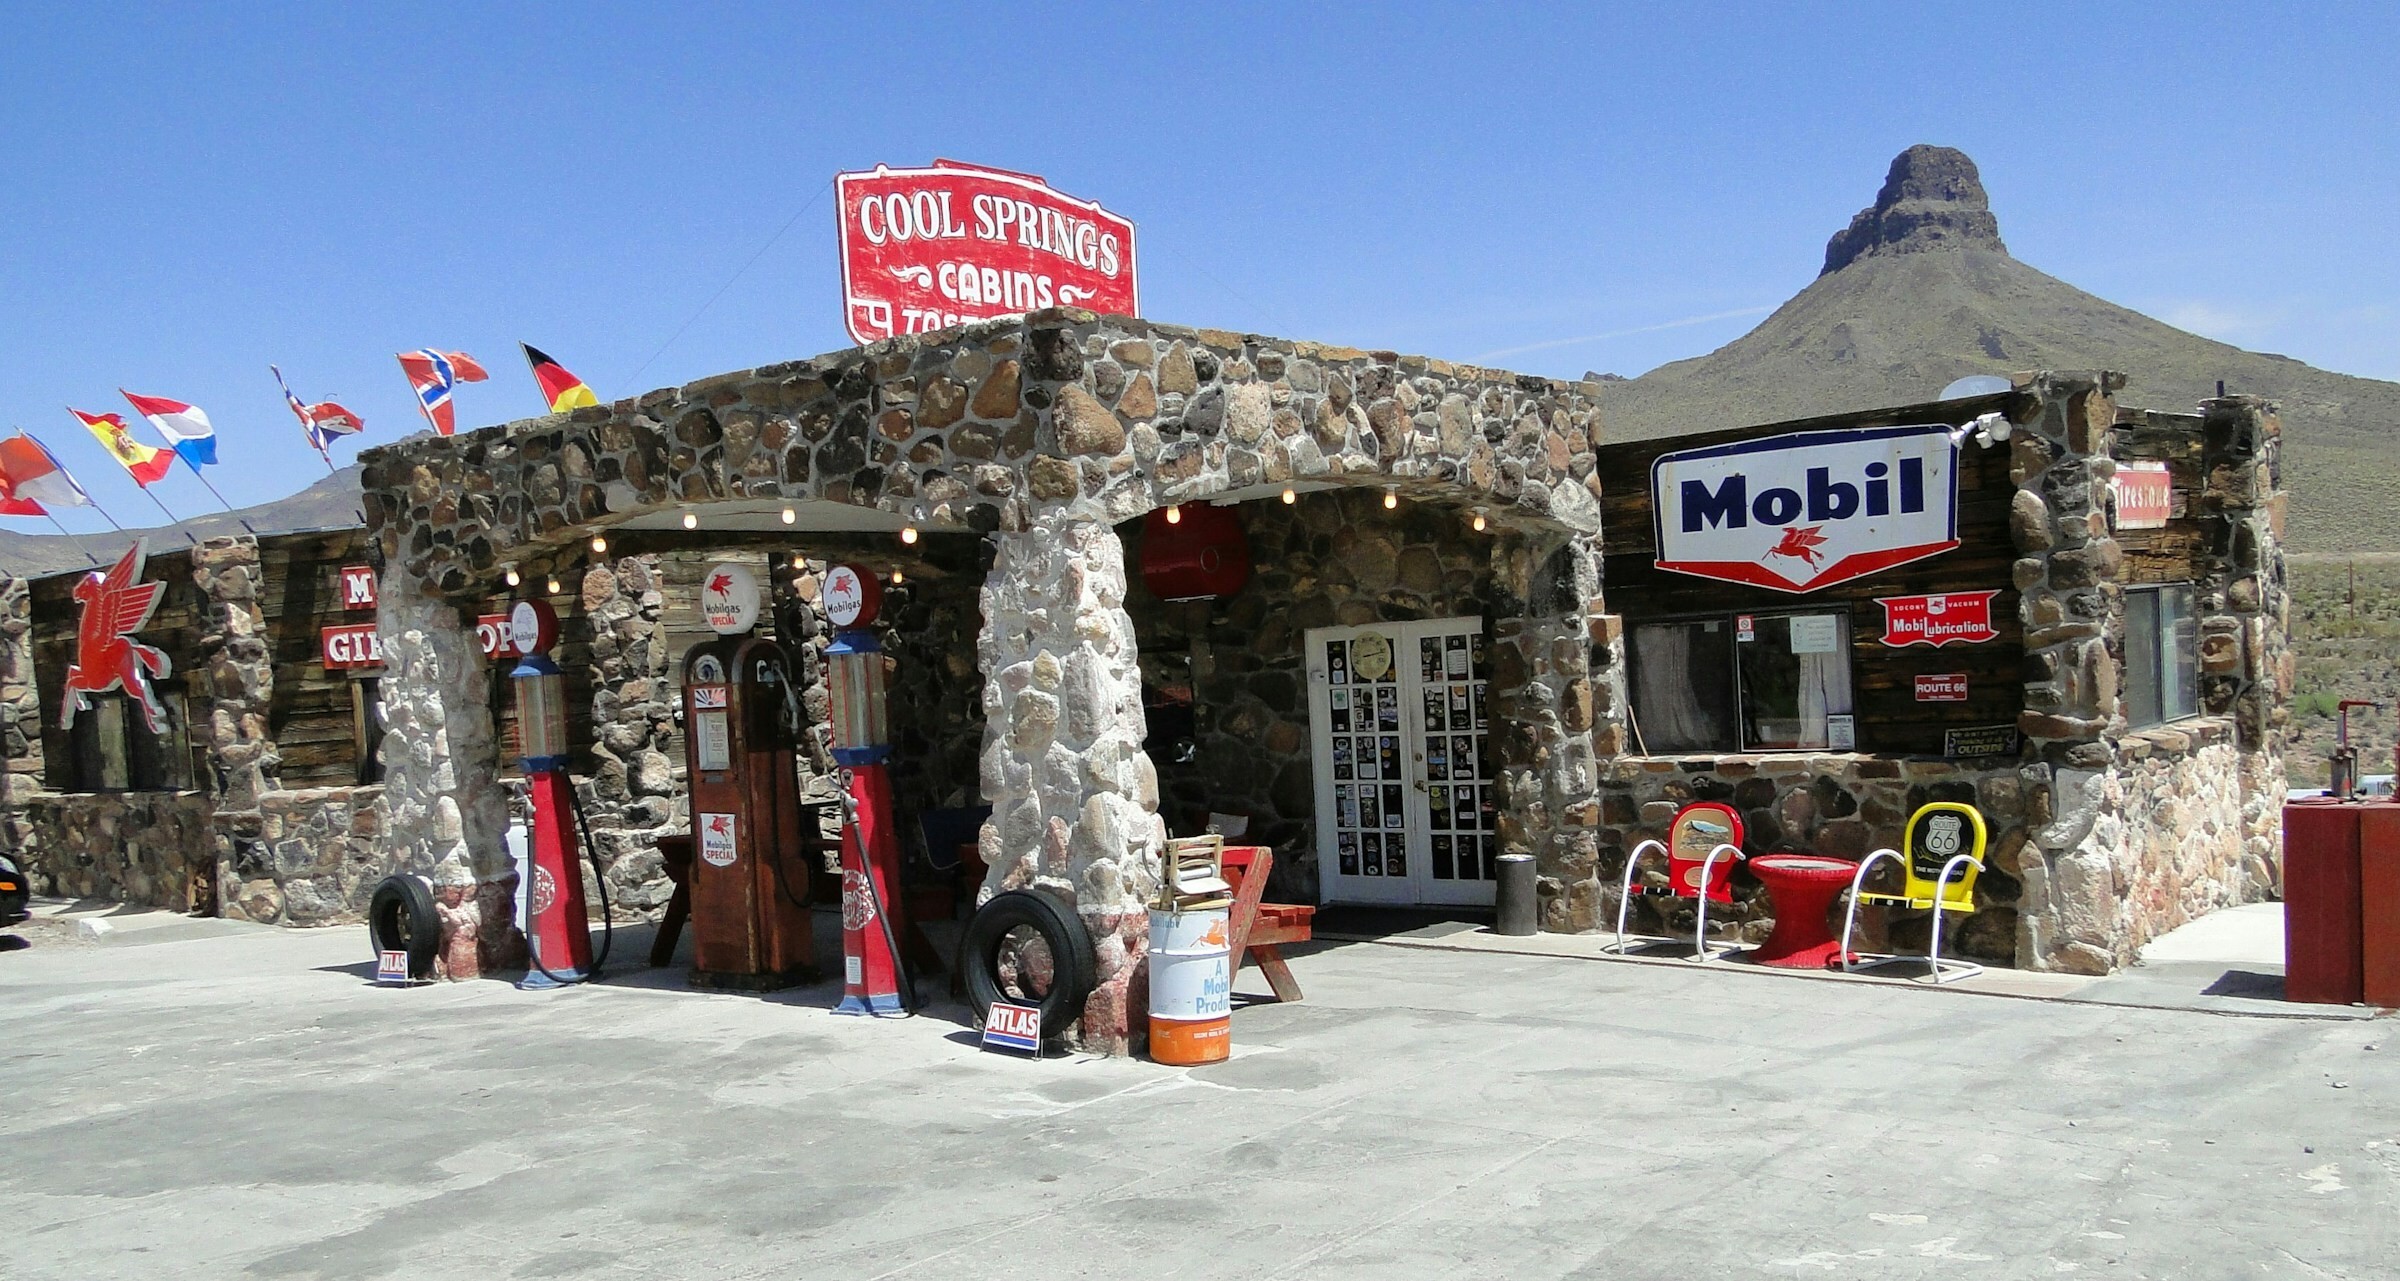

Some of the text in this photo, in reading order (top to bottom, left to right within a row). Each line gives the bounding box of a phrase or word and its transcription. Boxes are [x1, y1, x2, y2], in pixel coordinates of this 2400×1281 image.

[860, 191, 1119, 277] COOL SPRINGS
[1681, 457, 1924, 532] Mobil
[705, 602, 741, 616] Mobilgas
[827, 599, 861, 614] Mobilgas
[711, 615, 737, 626] SPECIAL
[1916, 683, 1966, 693] ROUTE 66
[1933, 820, 1957, 829] ROUTE
[706, 840, 733, 851] Mobilgas
[1931, 831, 1956, 849] 66
[706, 850, 735, 860] SPECIAL
[380, 953, 405, 972] ATLAS
[1215, 959, 1222, 976] A
[1203, 976, 1229, 996] Mobi
[988, 1006, 1038, 1037] ATLAS
